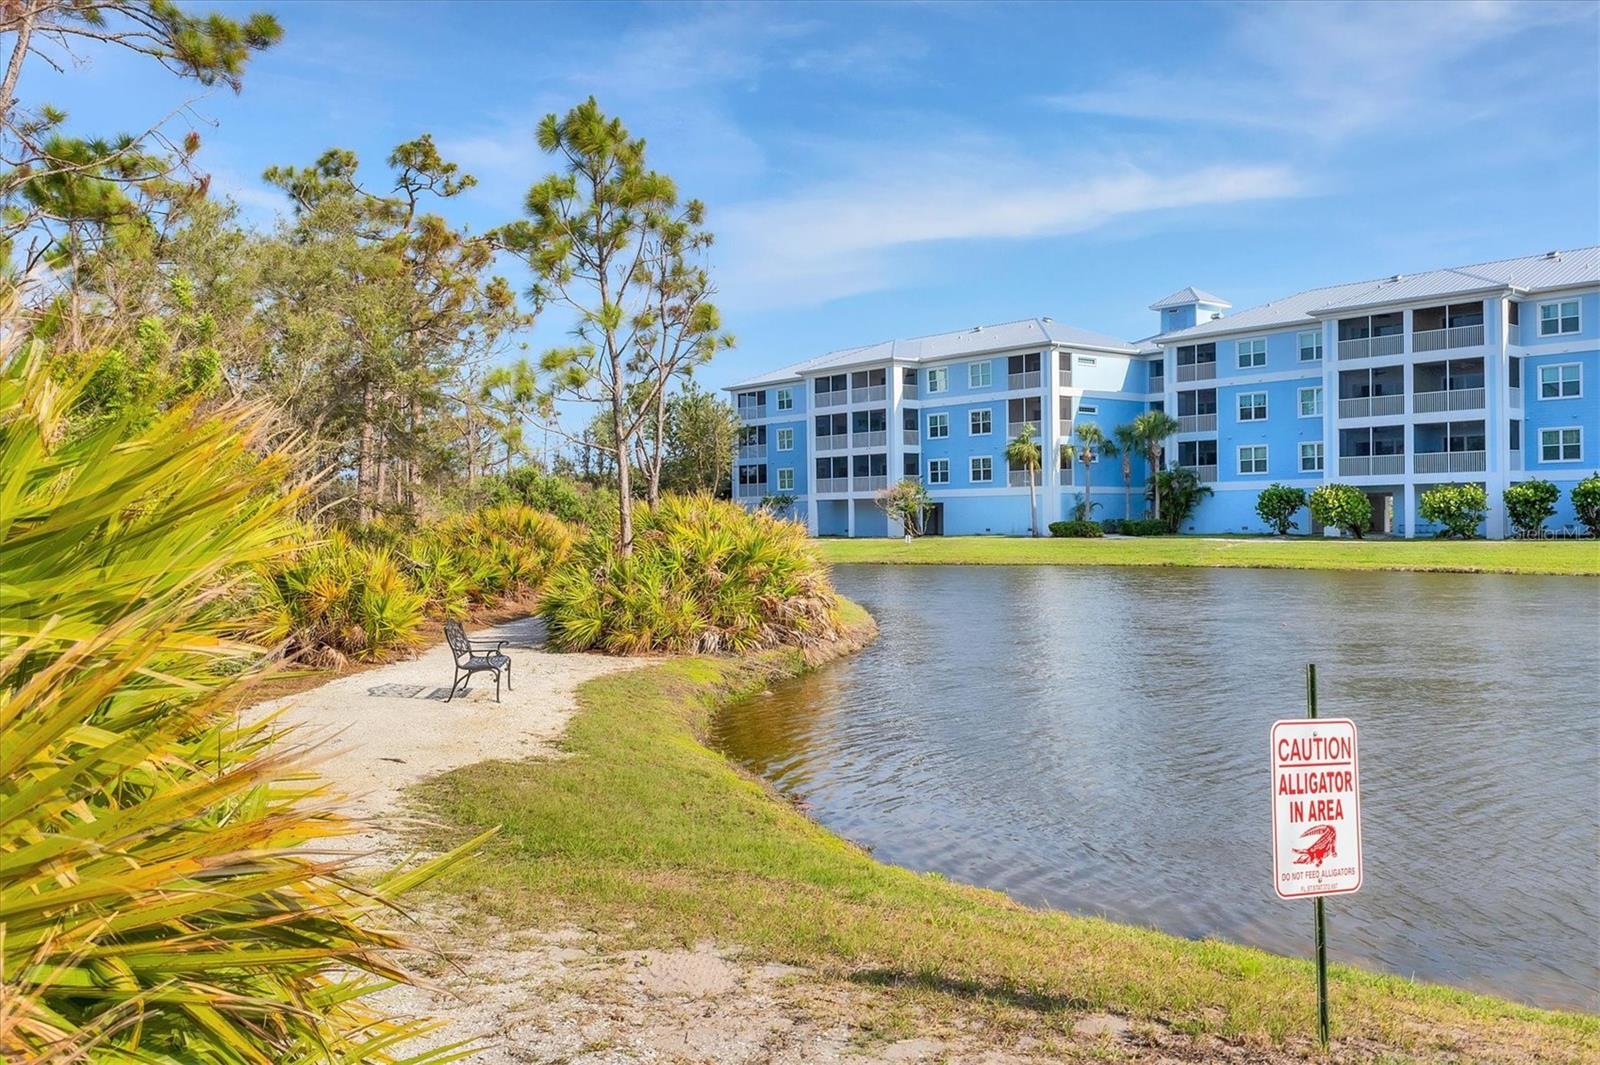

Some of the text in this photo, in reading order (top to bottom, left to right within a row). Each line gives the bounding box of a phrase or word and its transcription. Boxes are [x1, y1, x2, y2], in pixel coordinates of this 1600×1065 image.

[1278, 736, 1352, 762] CAUTION
[1278, 771, 1353, 796] ALLIGATOR
[1289, 799, 1344, 823] IN AREA
[1281, 867, 1355, 881] DO NOT FEED ALLIGATORS
